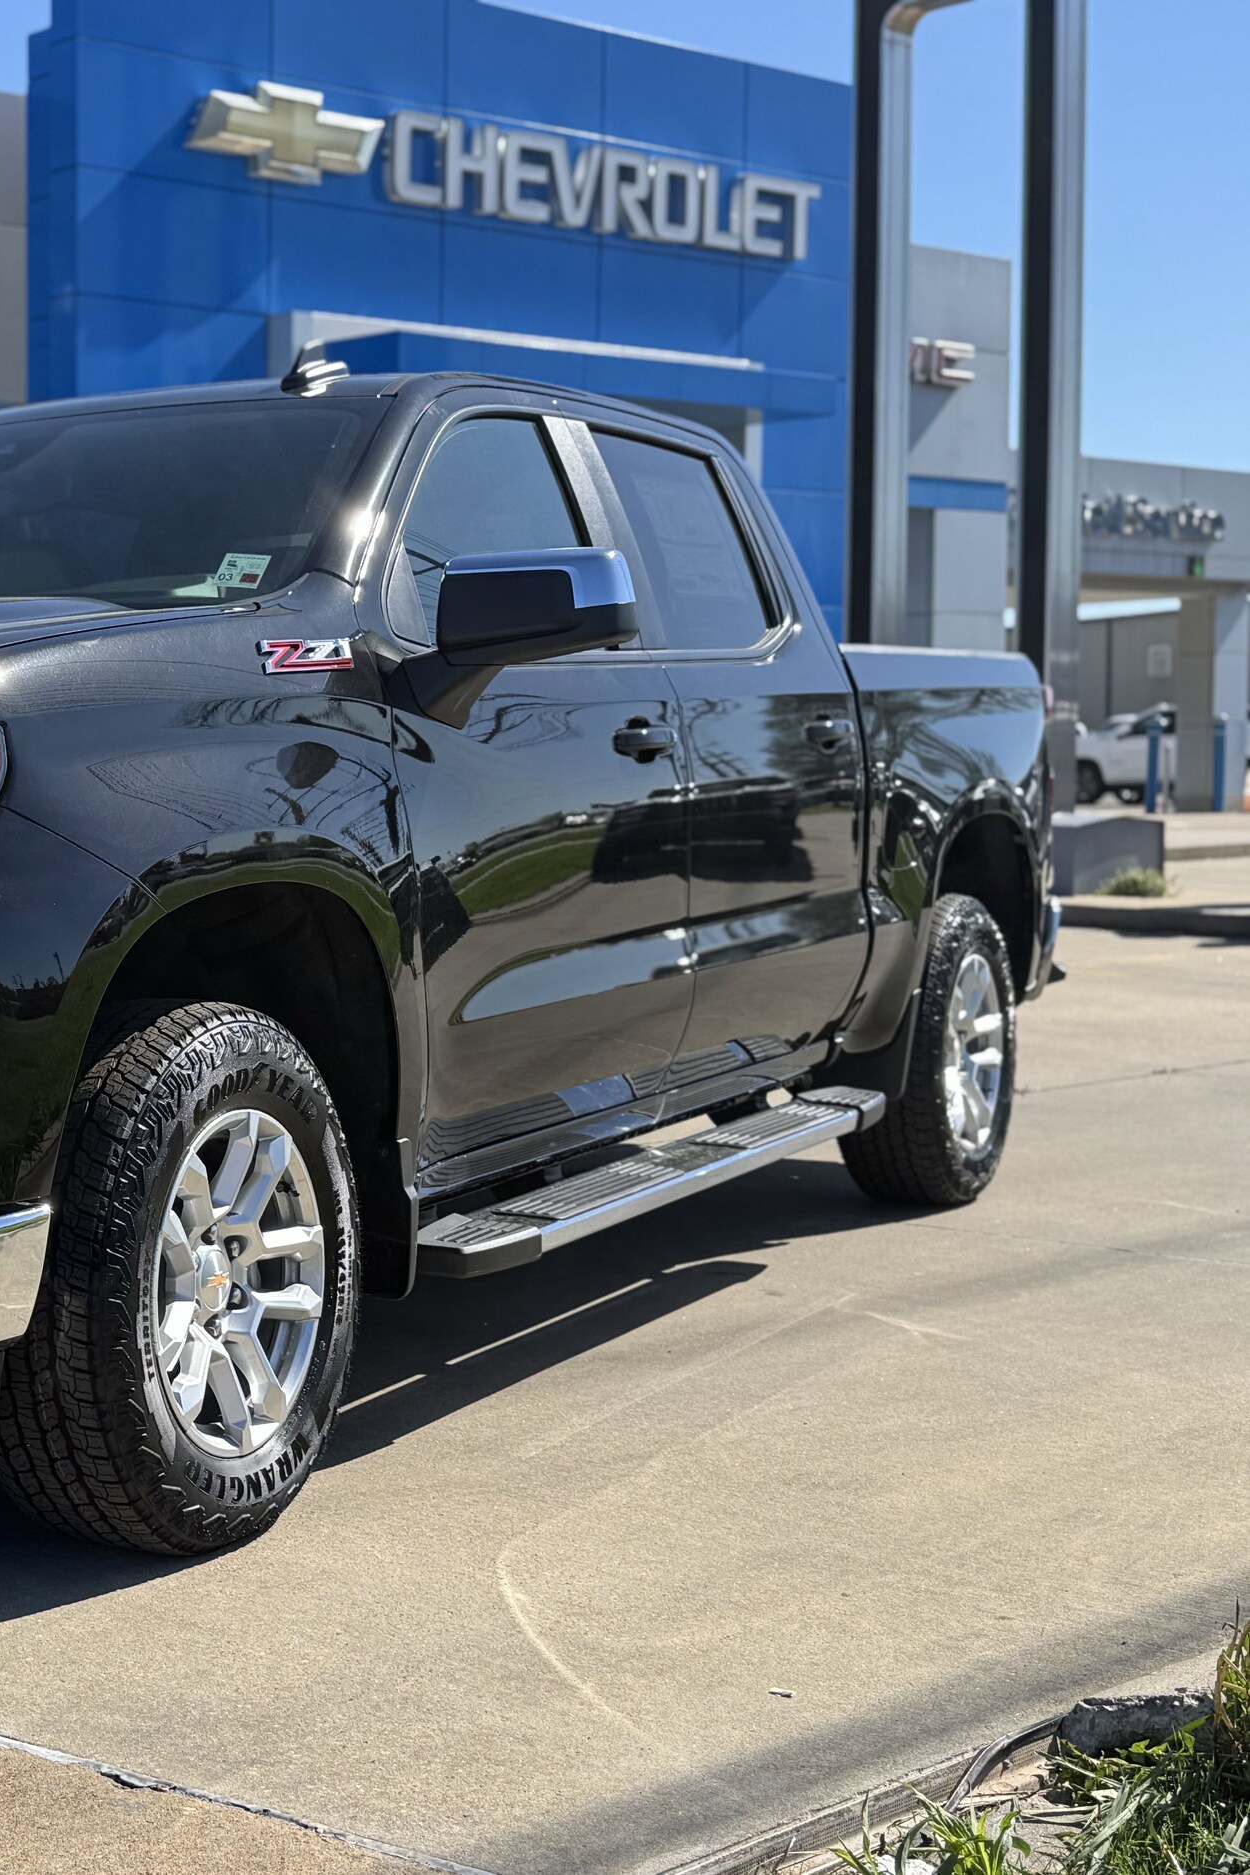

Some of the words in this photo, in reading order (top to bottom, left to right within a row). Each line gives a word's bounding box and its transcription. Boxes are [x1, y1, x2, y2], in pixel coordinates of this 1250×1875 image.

[383, 108, 821, 262] CHEVROLET
[218, 572, 234, 581] 03
[255, 638, 354, 675] Z71
[184, 1432, 310, 1502] WRANGLER
